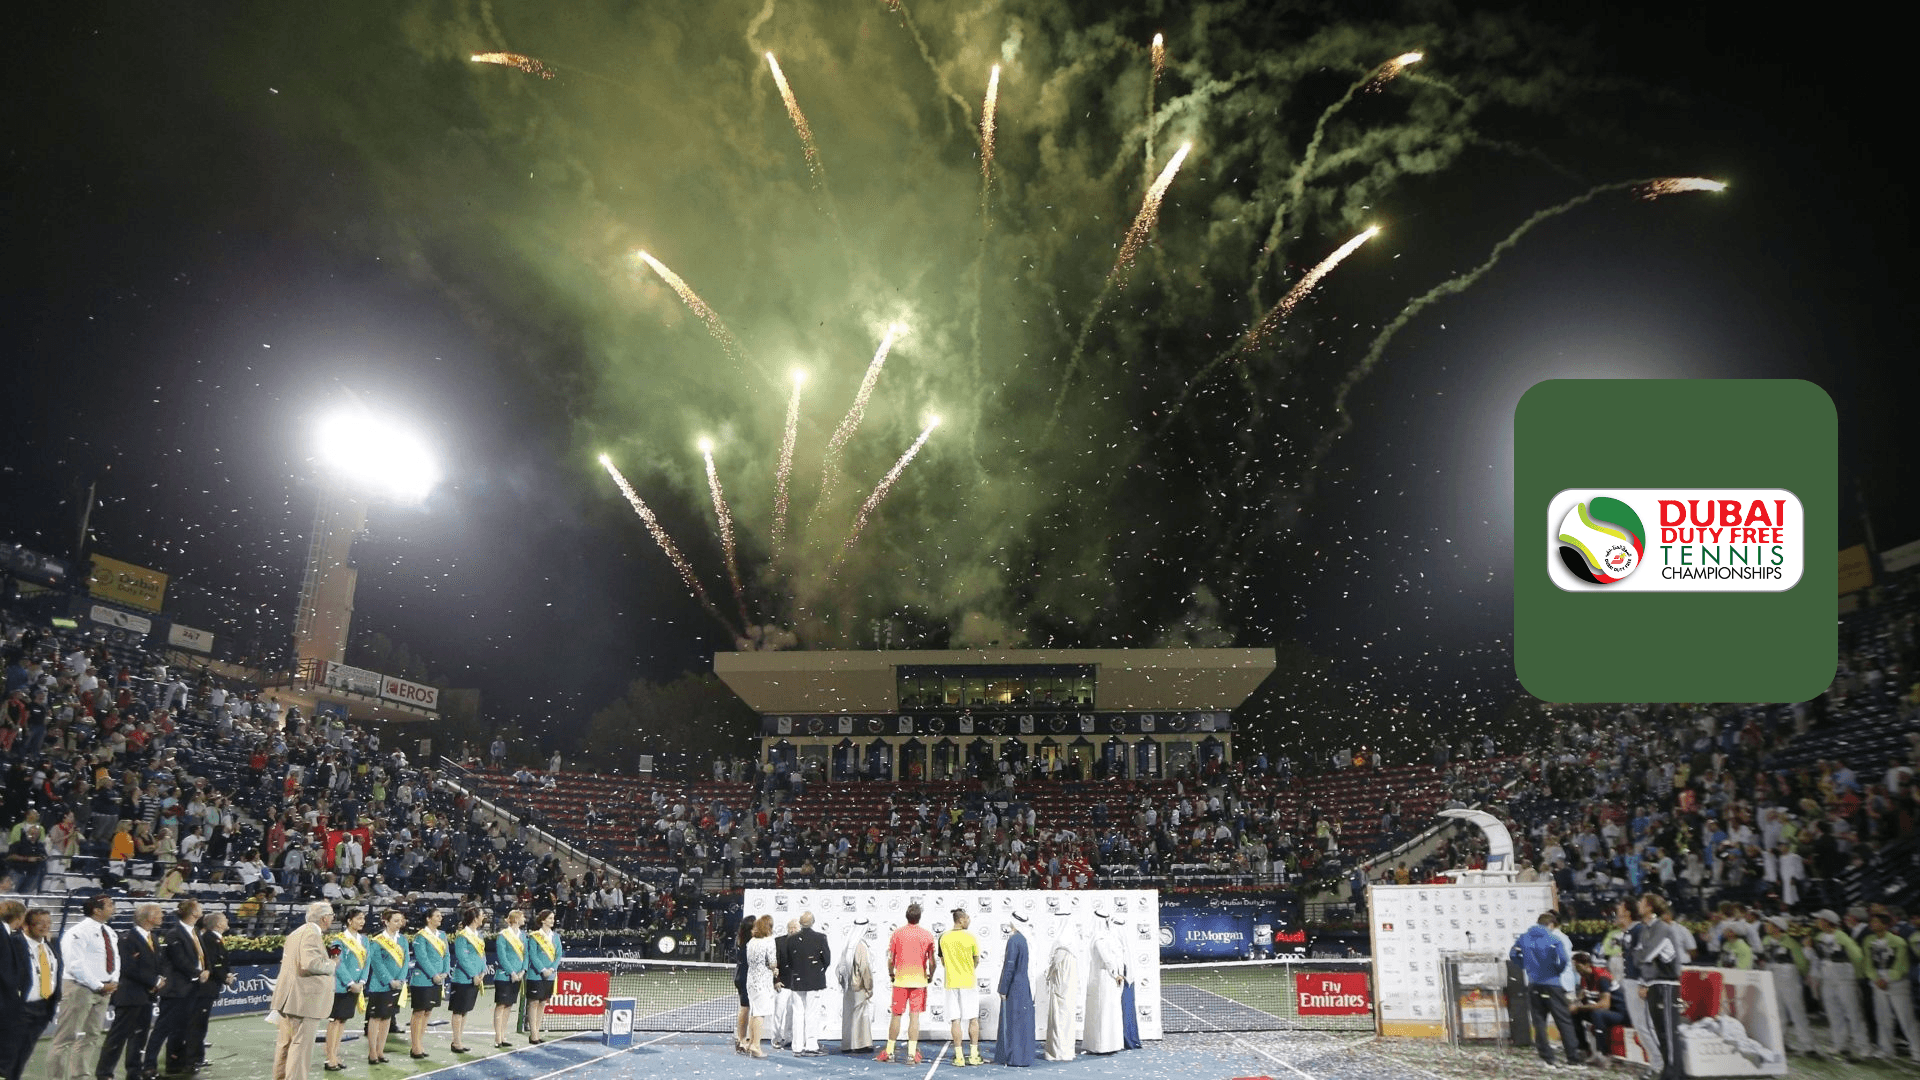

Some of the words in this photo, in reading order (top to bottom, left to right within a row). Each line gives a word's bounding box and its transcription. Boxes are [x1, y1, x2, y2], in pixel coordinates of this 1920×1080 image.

[399, 682, 434, 704] EROS
[1275, 931, 1306, 943] Audi
[563, 980, 582, 992] Fly
[1322, 981, 1342, 993] Fly
[547, 991, 604, 1007] mirates
[1300, 992, 1364, 1008] Emirates
